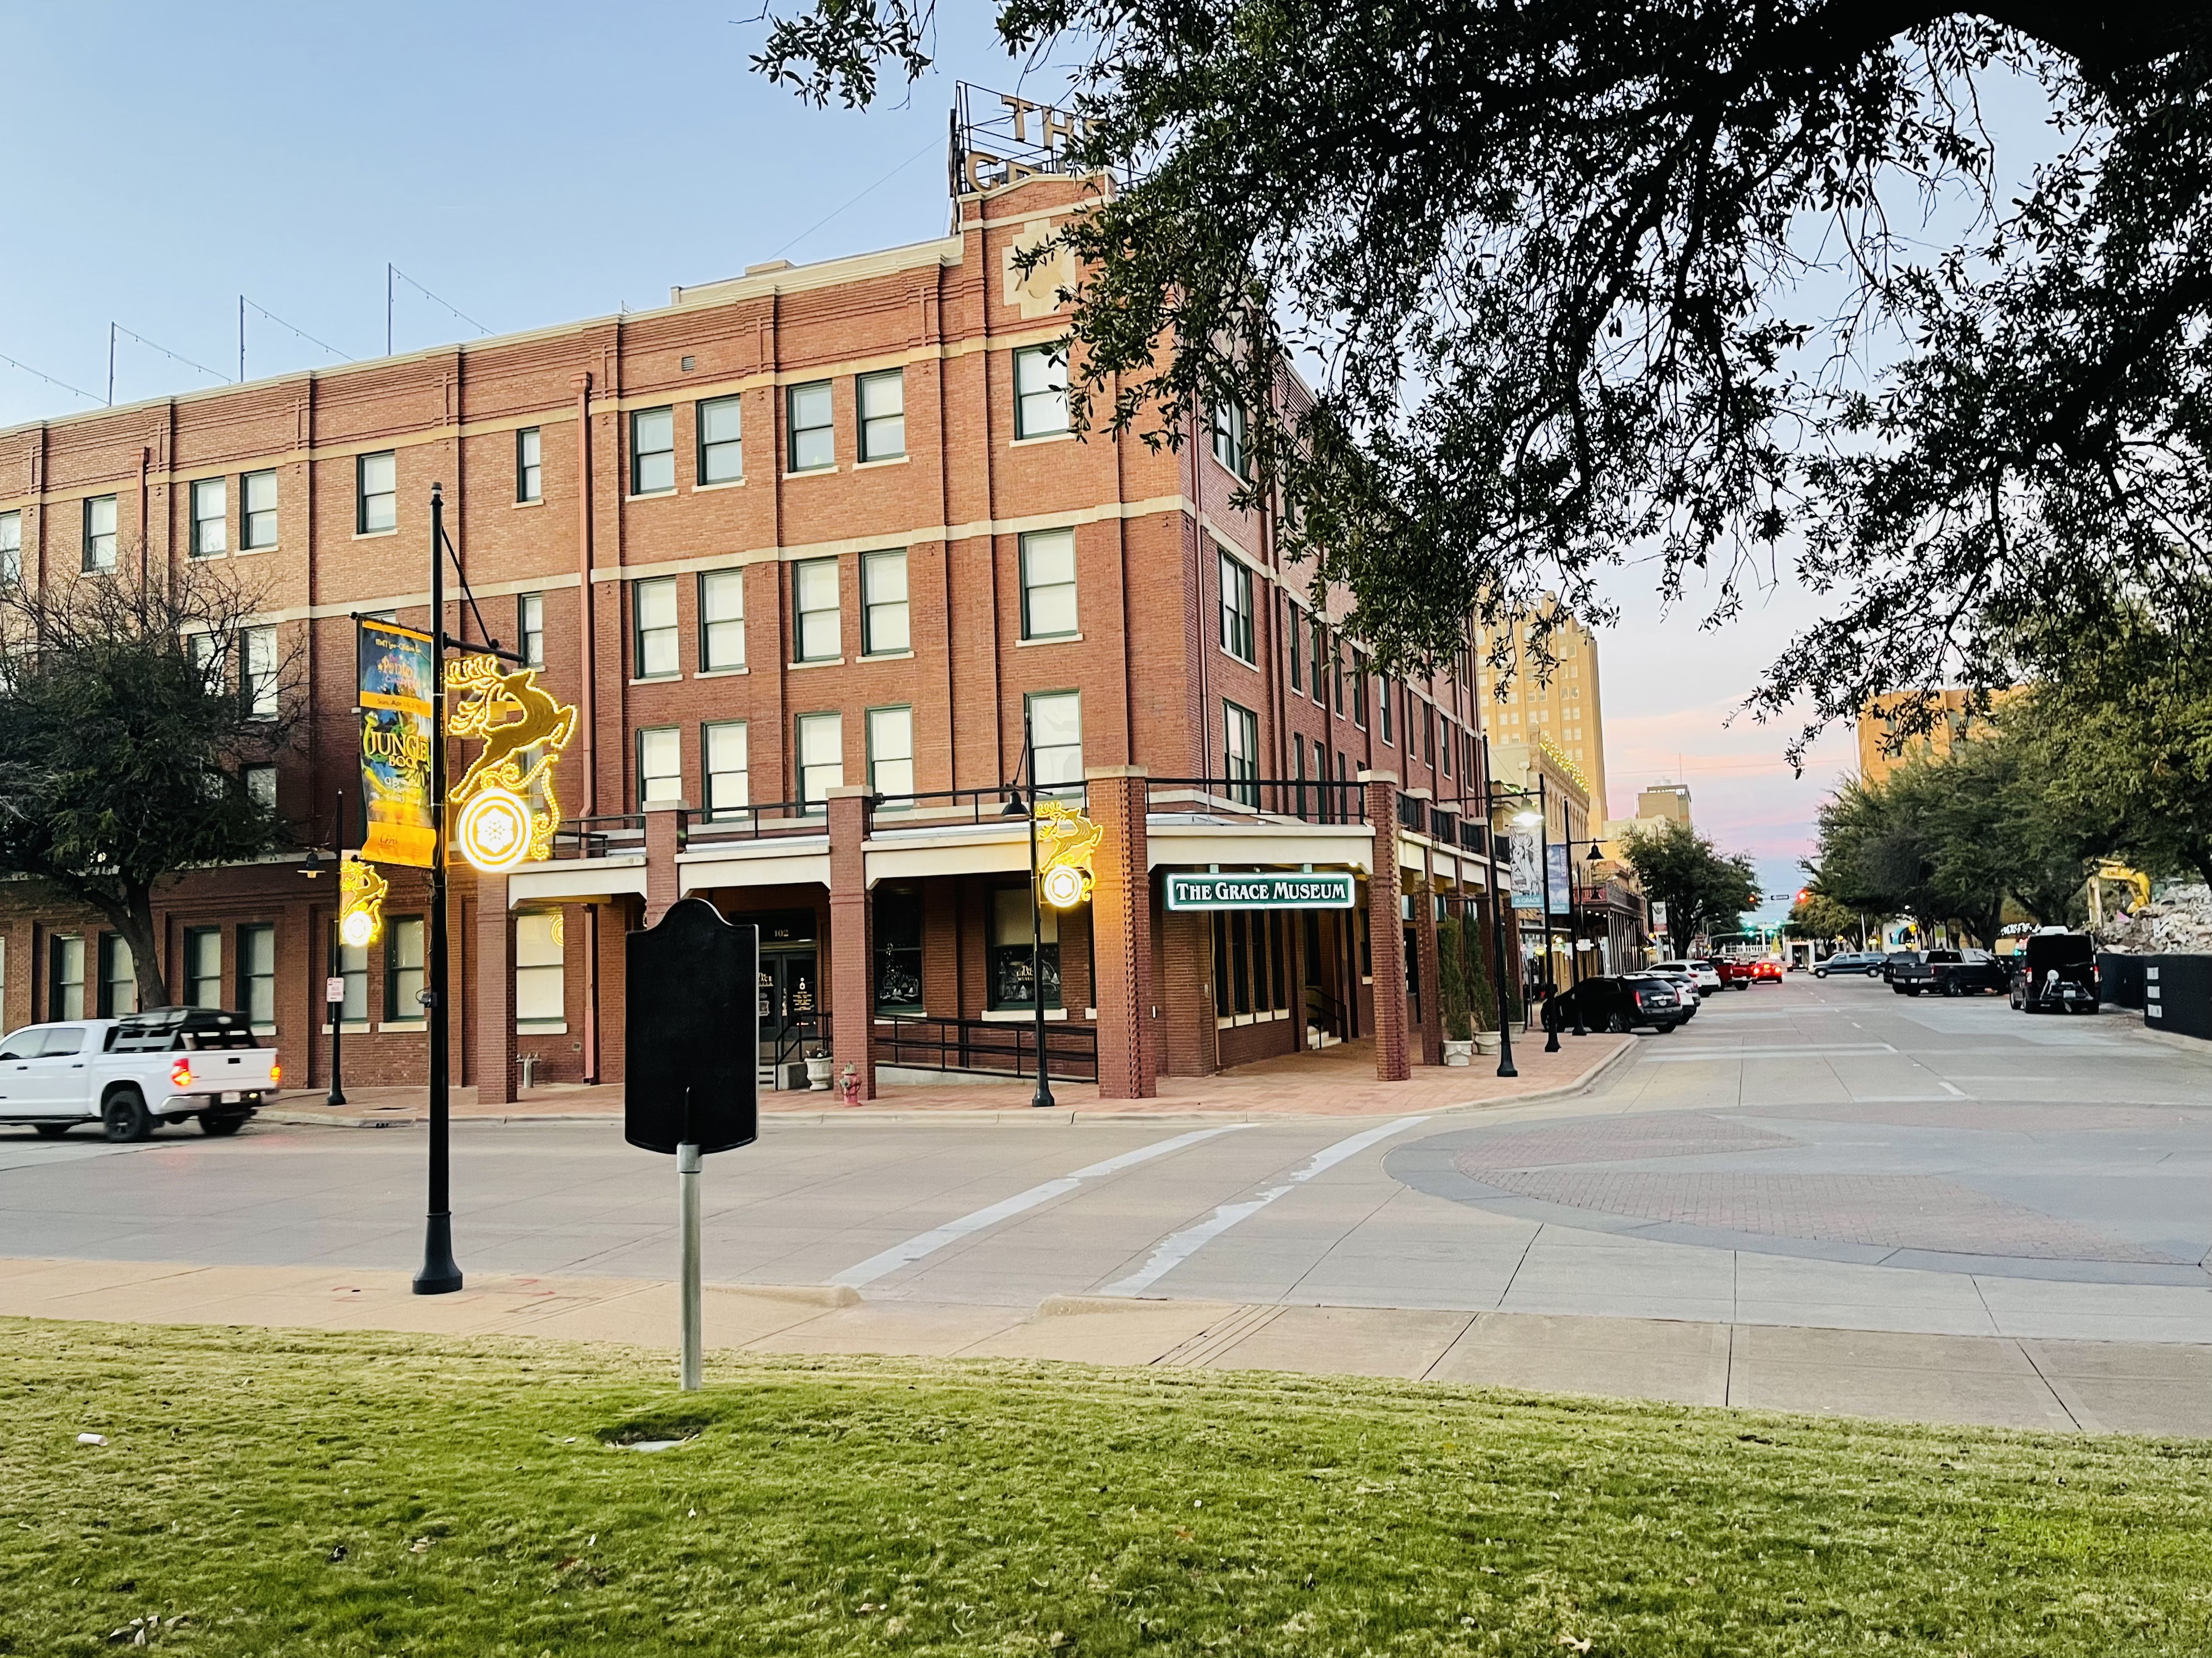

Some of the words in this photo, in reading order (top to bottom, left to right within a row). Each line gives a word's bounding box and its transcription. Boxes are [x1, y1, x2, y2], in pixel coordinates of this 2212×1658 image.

[369, 731, 427, 762] JUNGLE
[389, 755, 419, 770] BOOK
[1176, 882, 1212, 900] THE
[1215, 882, 1269, 900] GRACE
[1273, 882, 1346, 900] MUSEUM
